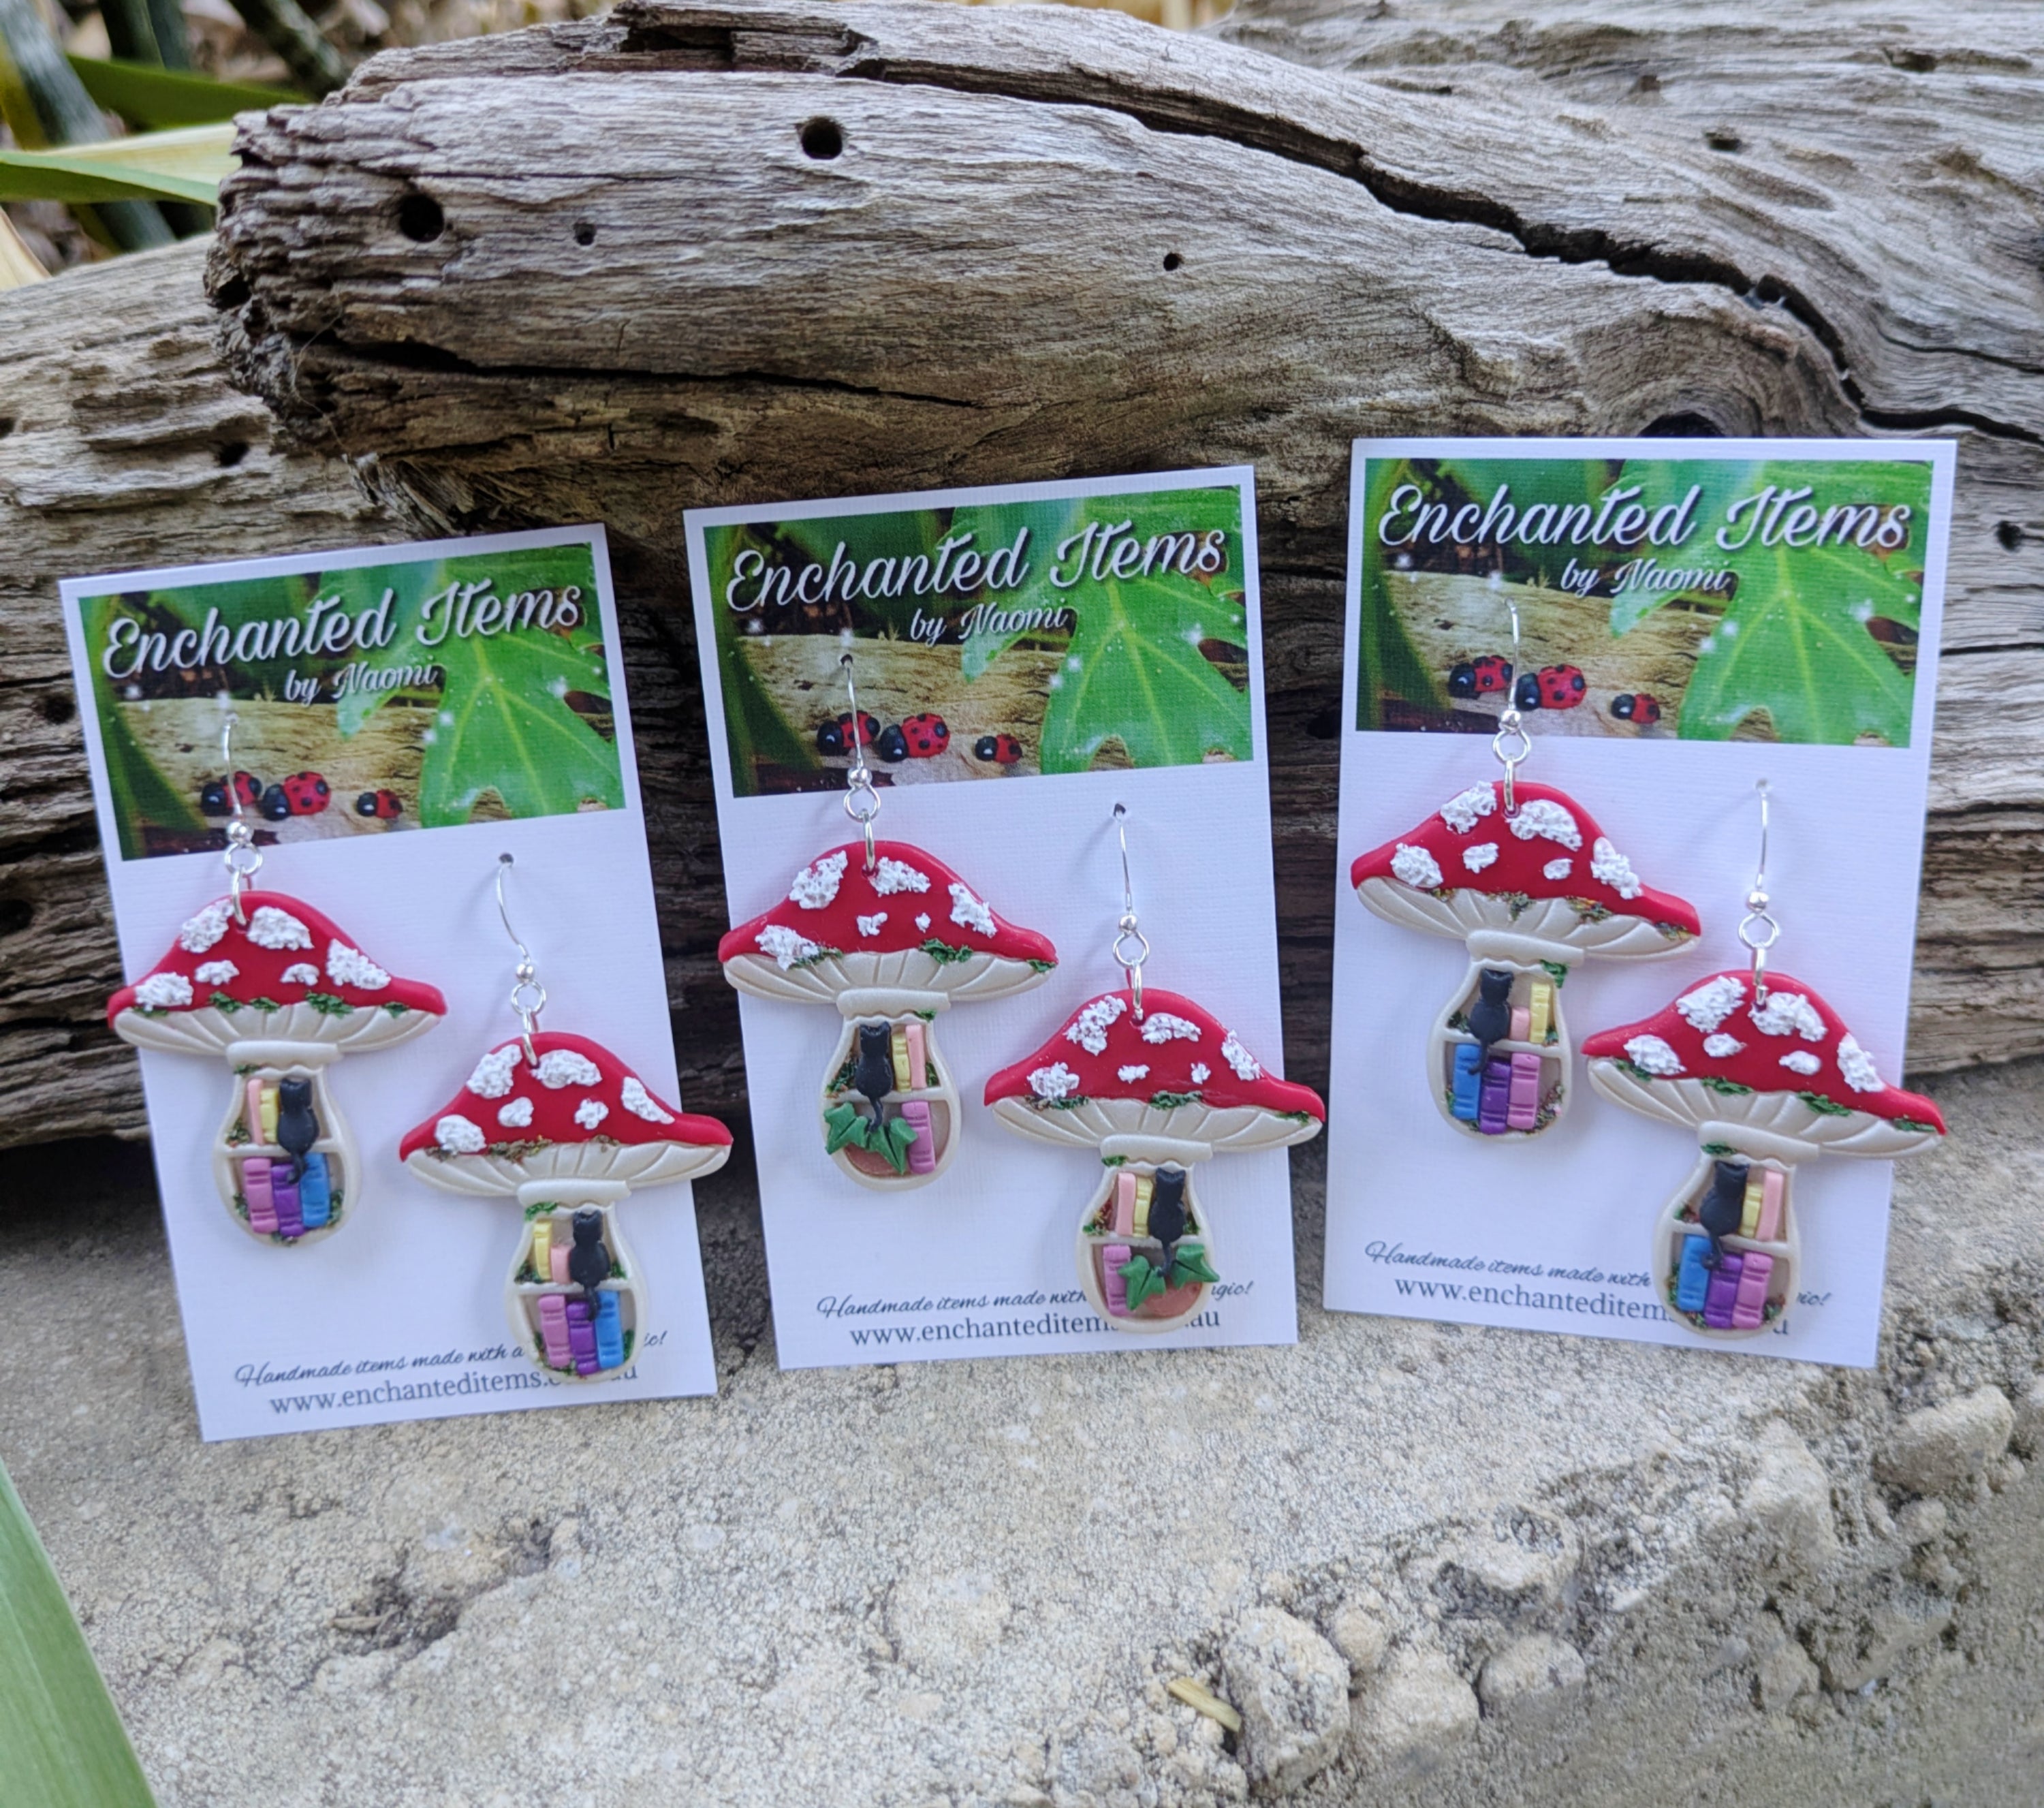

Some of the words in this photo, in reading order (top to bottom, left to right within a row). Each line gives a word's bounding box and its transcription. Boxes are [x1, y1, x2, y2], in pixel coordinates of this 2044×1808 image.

[1378, 483, 1696, 546] Enchanted
[1716, 485, 1911, 550] Items
[725, 527, 1030, 612] Enchanted
[1050, 520, 1225, 587] Items
[1560, 558, 1600, 597] by
[1609, 557, 1730, 593] Naomi
[103, 588, 396, 679] Enchanted
[415, 578, 582, 646] Items
[909, 608, 946, 645] by
[958, 599, 1068, 640] Naomi
[284, 670, 320, 706] by
[330, 655, 439, 700] Naomi
[1364, 1241, 1485, 1271] Handmade
[1488, 1260, 1543, 1277] items
[1547, 1267, 1603, 1282] made
[1608, 1271, 1651, 1287] with
[817, 1294, 934, 1318] Handmade
[937, 1295, 988, 1310] items
[993, 1290, 1045, 1306] made
[1050, 1290, 1087, 1304] with
[234, 1361, 352, 1387] Handmade
[356, 1355, 407, 1374] items
[412, 1349, 464, 1367] made
[469, 1345, 506, 1362] with
[512, 1345, 524, 1358] a
